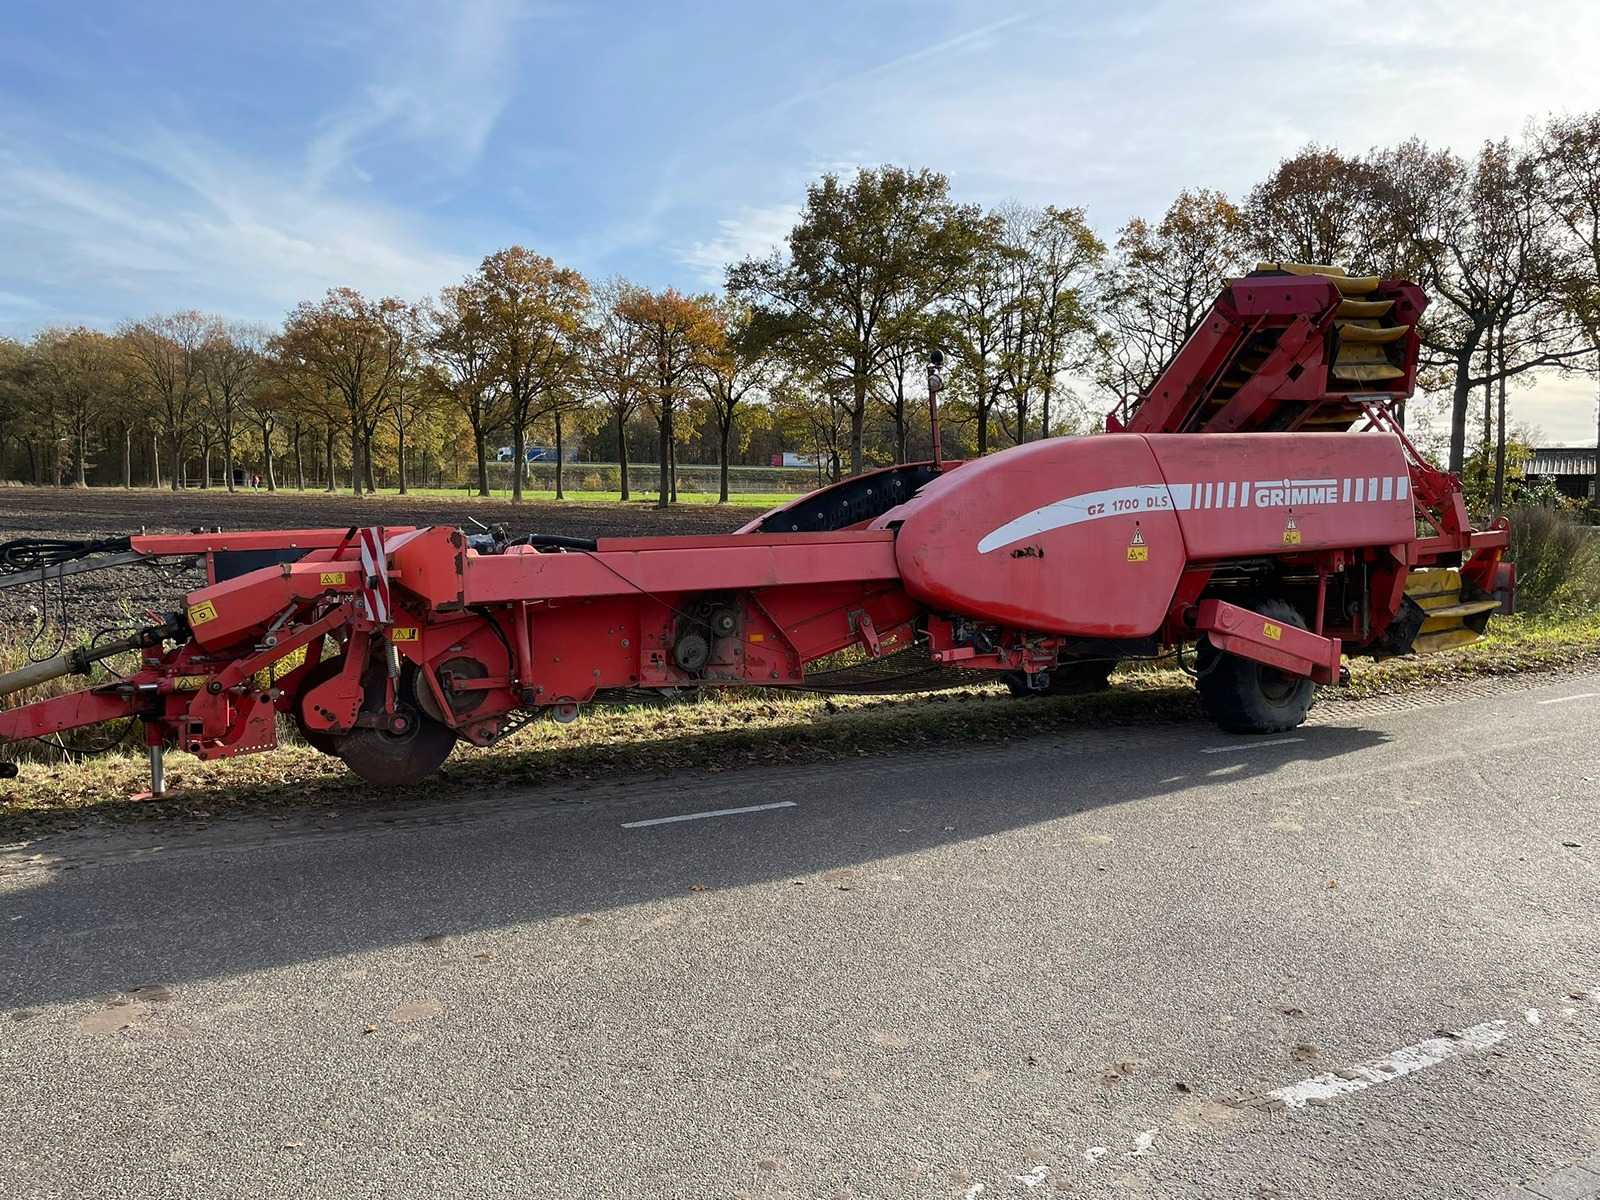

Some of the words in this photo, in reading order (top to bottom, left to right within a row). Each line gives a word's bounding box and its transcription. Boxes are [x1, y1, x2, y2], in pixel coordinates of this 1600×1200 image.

[1255, 479, 1338, 507] GRIMME
[1087, 503, 1105, 515] GZ
[1112, 499, 1139, 511] 1700
[1147, 496, 1168, 508] DLS
